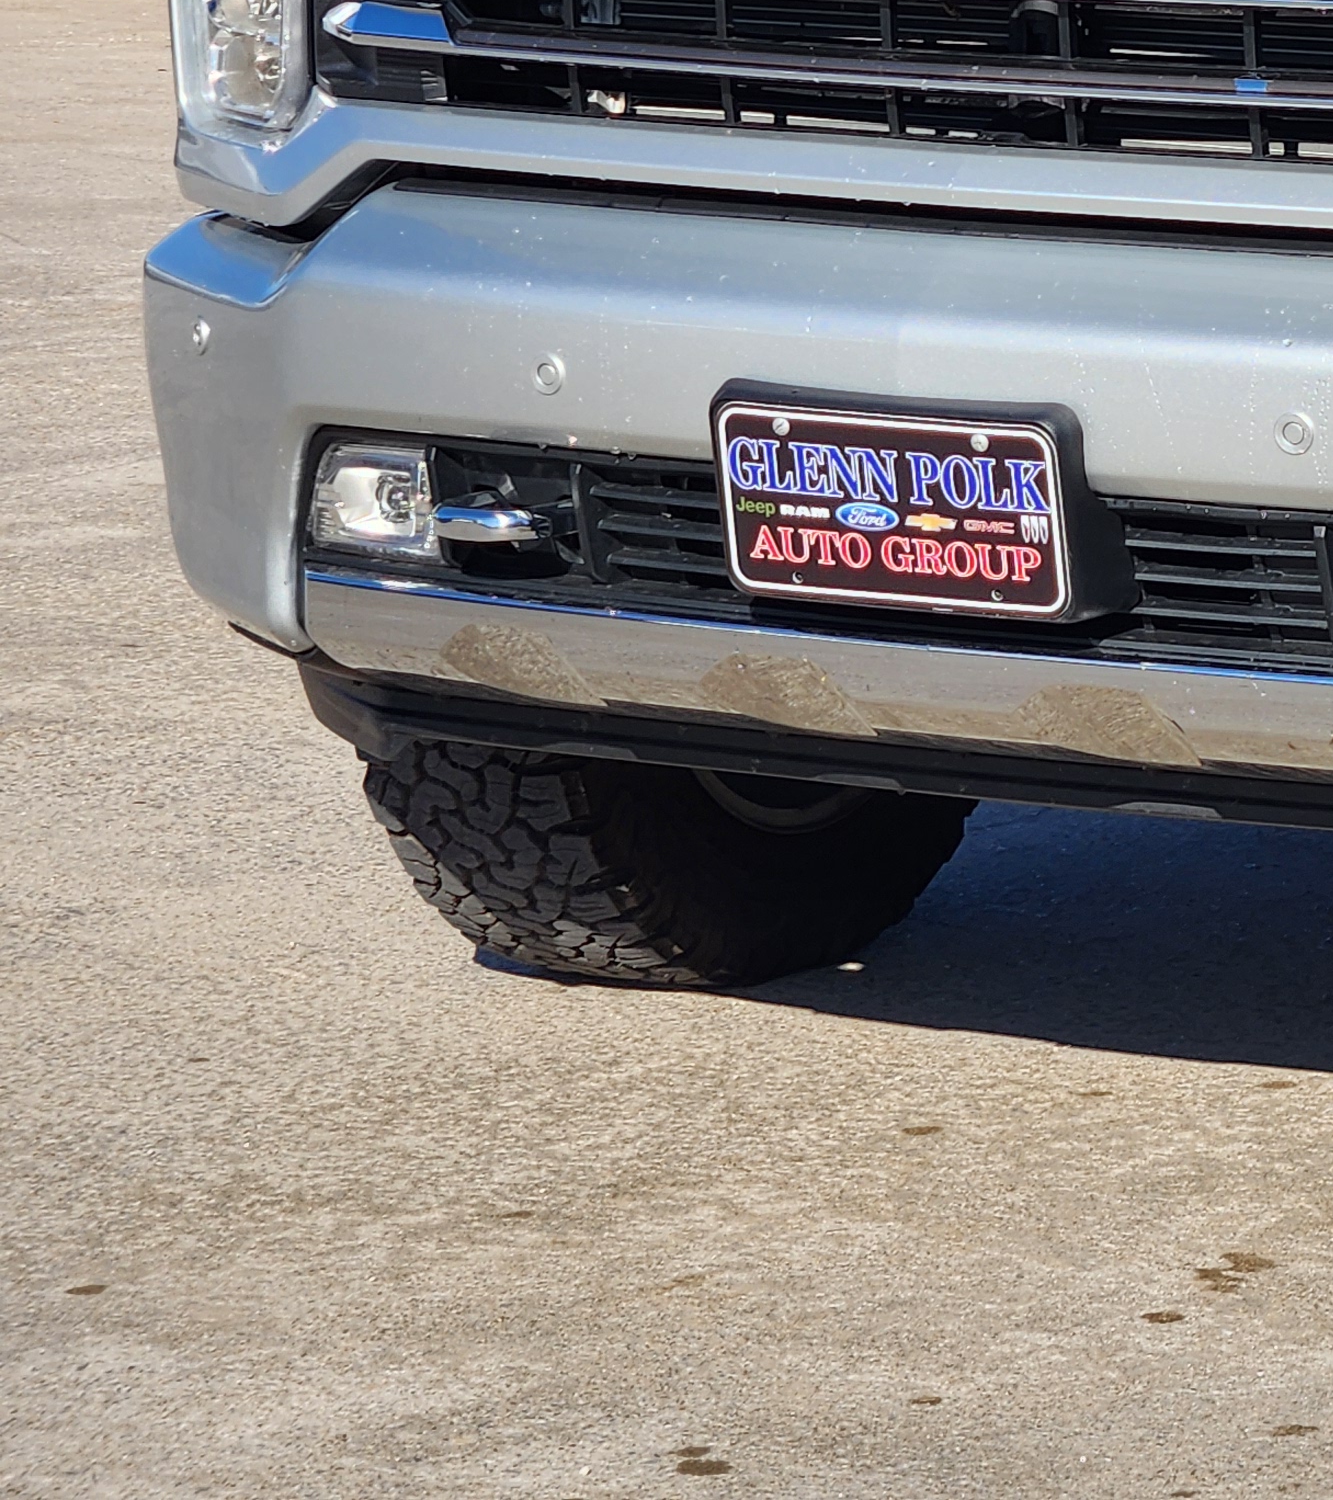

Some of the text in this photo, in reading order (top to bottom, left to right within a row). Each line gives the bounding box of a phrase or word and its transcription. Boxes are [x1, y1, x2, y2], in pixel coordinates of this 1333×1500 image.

[728, 435, 1052, 514] GLENN POLK
[735, 496, 776, 518] Jeep
[779, 503, 831, 519] RAM
[963, 519, 1016, 535] GMC
[749, 524, 1042, 582] AUTO GROUP
